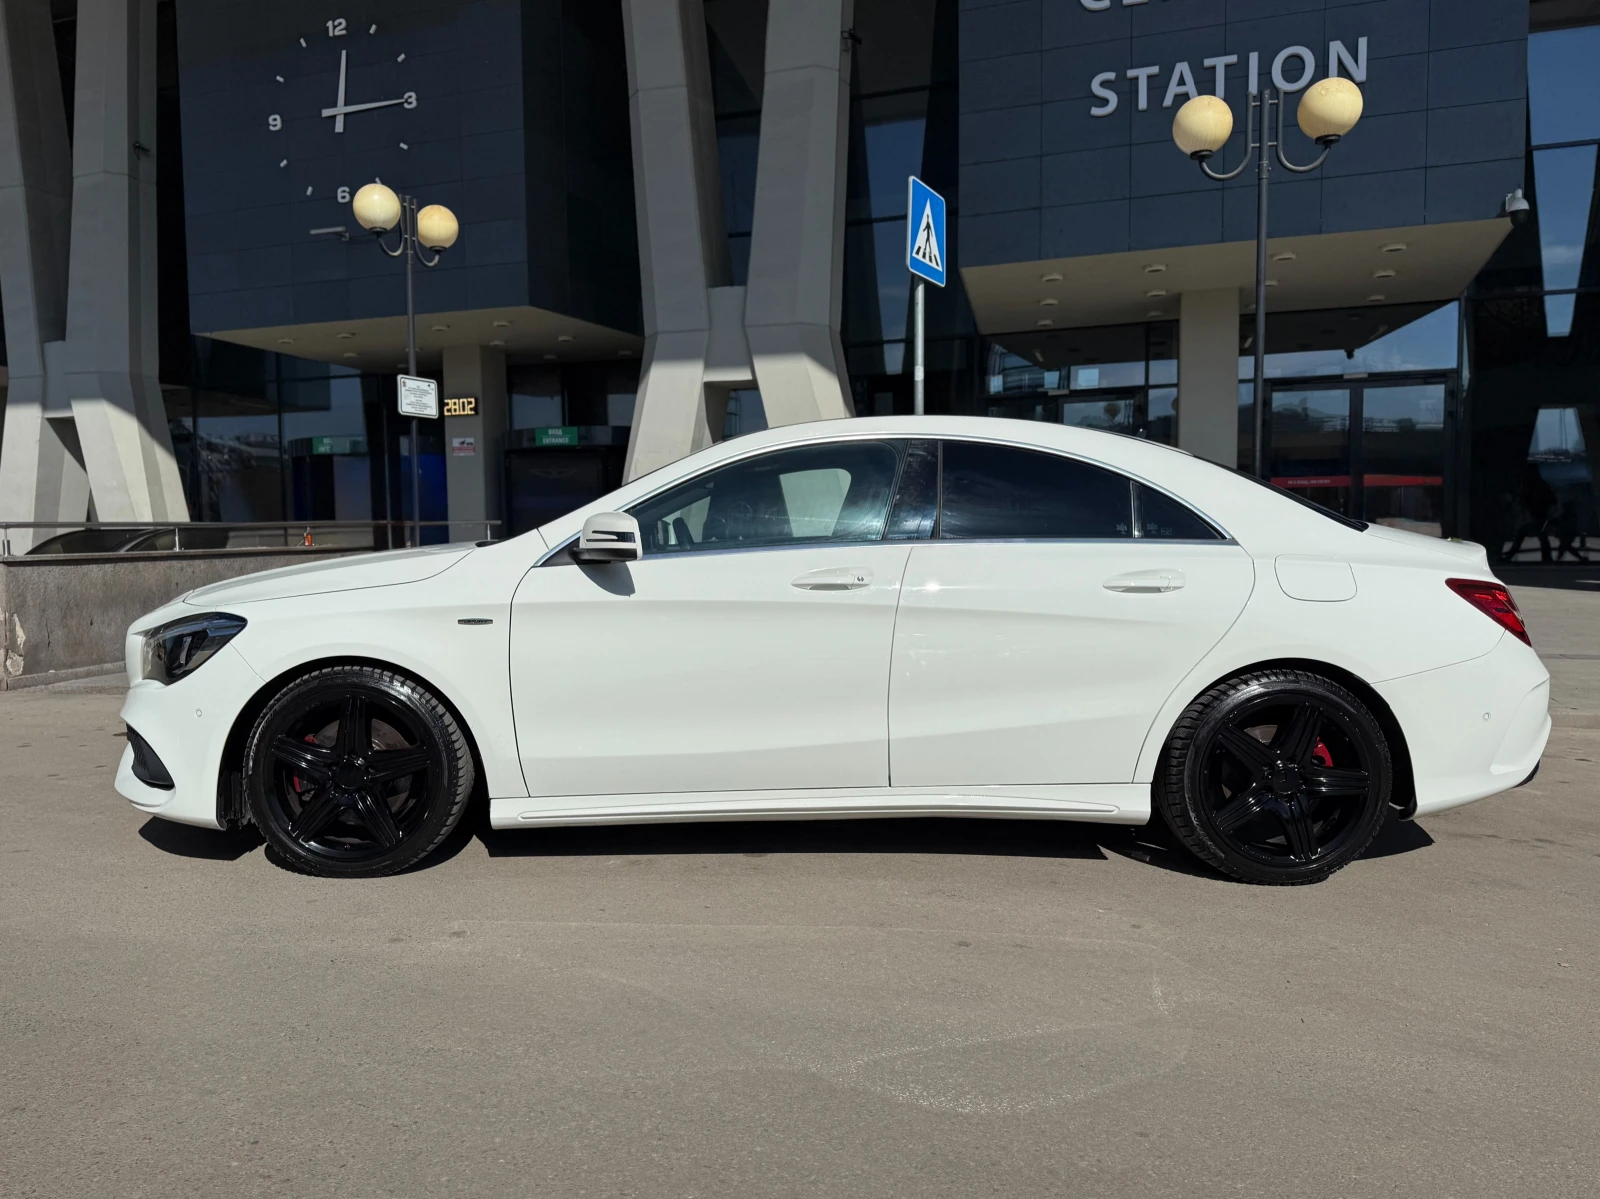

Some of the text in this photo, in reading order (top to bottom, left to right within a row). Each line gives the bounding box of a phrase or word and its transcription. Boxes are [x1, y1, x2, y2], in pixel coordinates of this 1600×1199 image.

[326, 18, 347, 37] 12
[1090, 36, 1368, 117] STATION
[403, 92, 417, 109] 3
[268, 114, 282, 131] 9
[337, 187, 350, 203] 6
